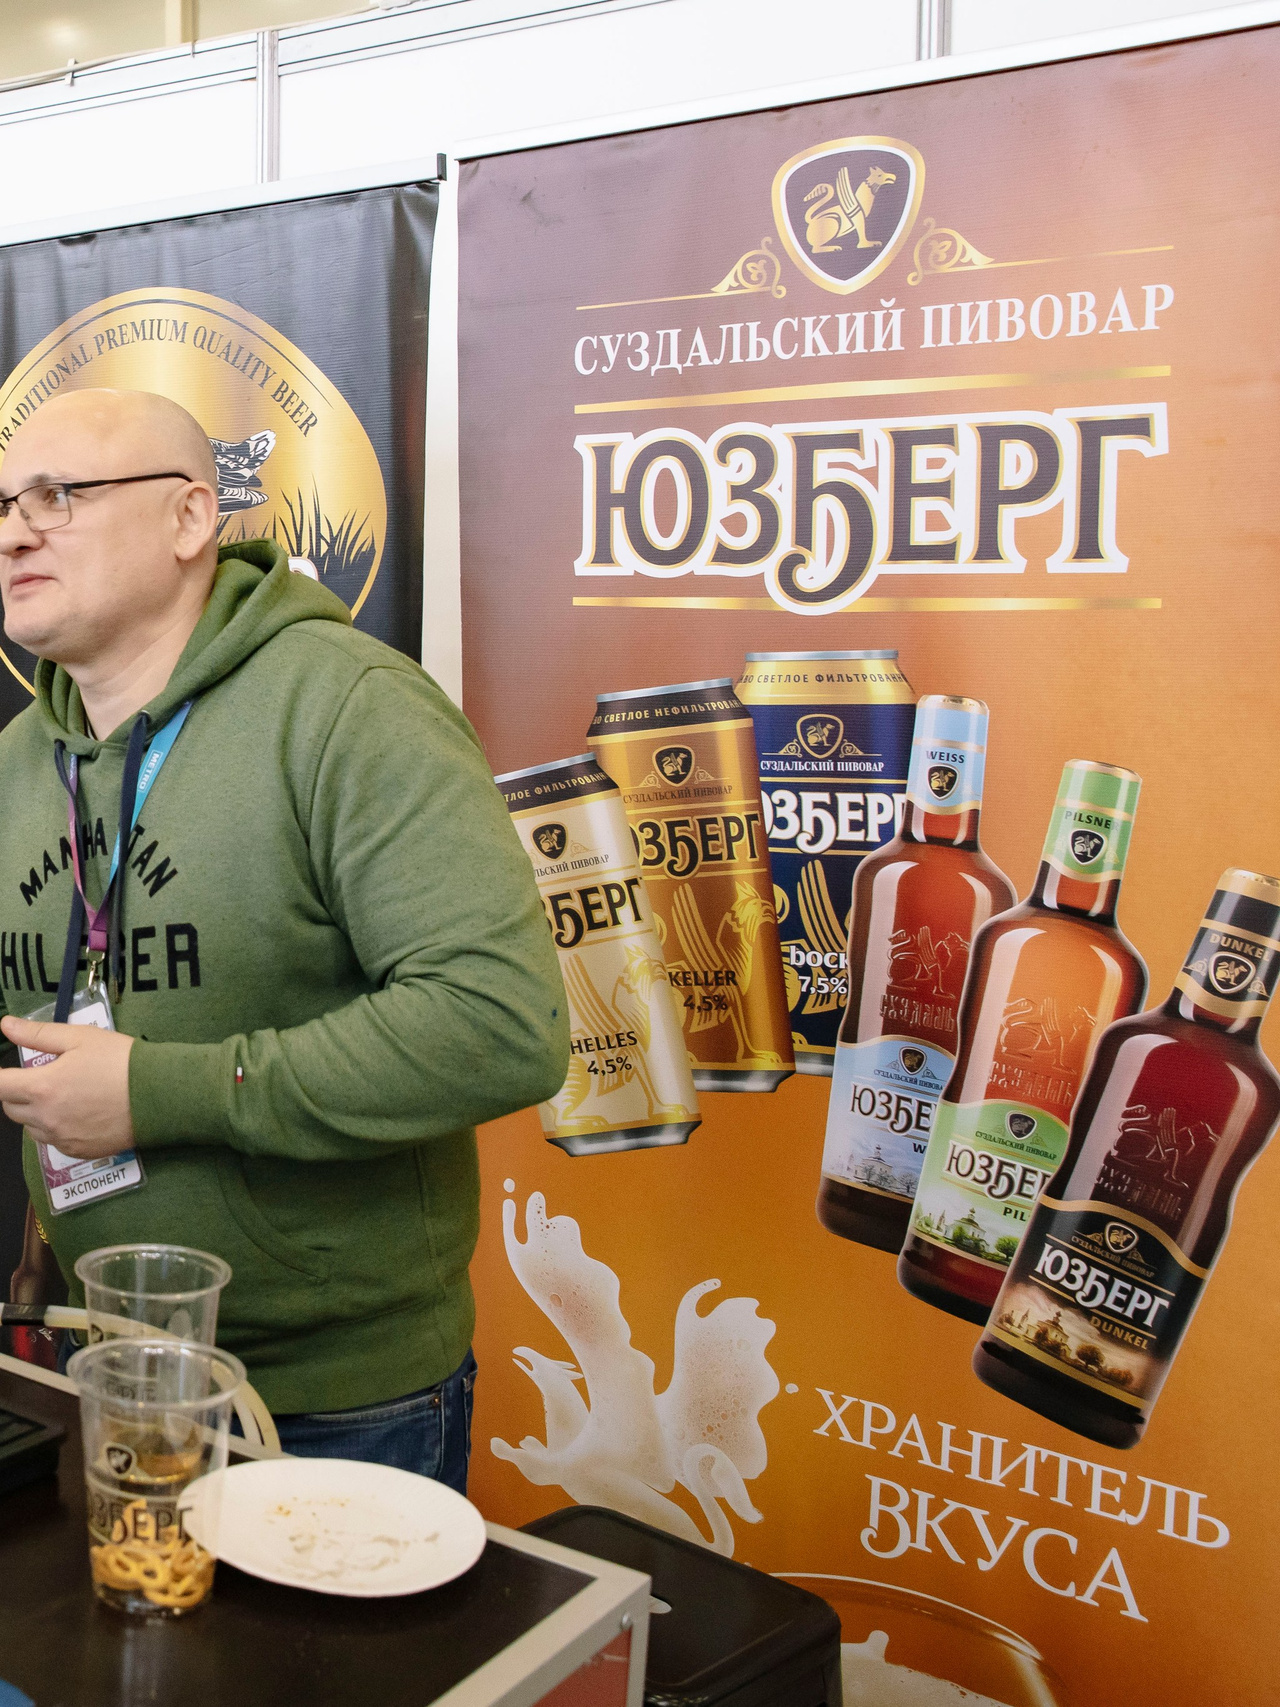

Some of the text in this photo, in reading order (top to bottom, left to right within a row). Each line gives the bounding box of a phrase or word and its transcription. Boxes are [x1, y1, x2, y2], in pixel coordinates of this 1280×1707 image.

[574, 283, 1175, 376] СУЗДАЛЬСКИЙ ПИВОВАР
[93, 318, 189, 356] PREMIUM
[193, 325, 277, 390] QUALITY
[270, 378, 318, 438] BEER
[573, 401, 1169, 616] ЮЗБЕРГ
[757, 674, 809, 683] СВЕТЛОЕ
[603, 709, 650, 724] СВЕТЛОЕ
[760, 759, 885, 772] СУЗДАЛЬСКИЙ ПИВОВАР
[926, 750, 966, 764] WEISS
[139, 752, 161, 790] METRO
[504, 788, 531, 803] ТЛОЕ
[623, 786, 692, 804] СУЗДАЛЬСКИЙ
[1064, 810, 1120, 832] PILSNER
[630, 812, 761, 878] ЗБЕРГ
[19, 817, 178, 907] MANHATAN
[534, 853, 610, 879] ЛЬСКИЙ ПИВОВАР
[542, 876, 643, 949] БЕРГ
[1209, 932, 1271, 961] DUNKEL
[668, 969, 739, 988] KELLER
[798, 975, 847, 994] 7,5%
[683, 994, 729, 1013] 4,5%
[571, 1030, 638, 1055] HELLES
[587, 1056, 633, 1076] 4,5%
[873, 1068, 944, 1092] СУЗДАЛЬСКИЙ ПИВОВА
[849, 1081, 938, 1136] ЮЗБЕ
[975, 1130, 1025, 1151] СУЗДАЛЬСКИЙ
[62, 1167, 126, 1200] ЭКСПОНЕНТ
[1002, 1206, 1031, 1222] PIL
[1034, 1242, 1170, 1328] ЮЗБЕРГ
[1090, 1314, 1149, 1351] DUNKEL
[813, 1387, 1231, 1549] ХРАНИТЕЛЬ
[860, 1474, 1149, 1622] ВКУСА
